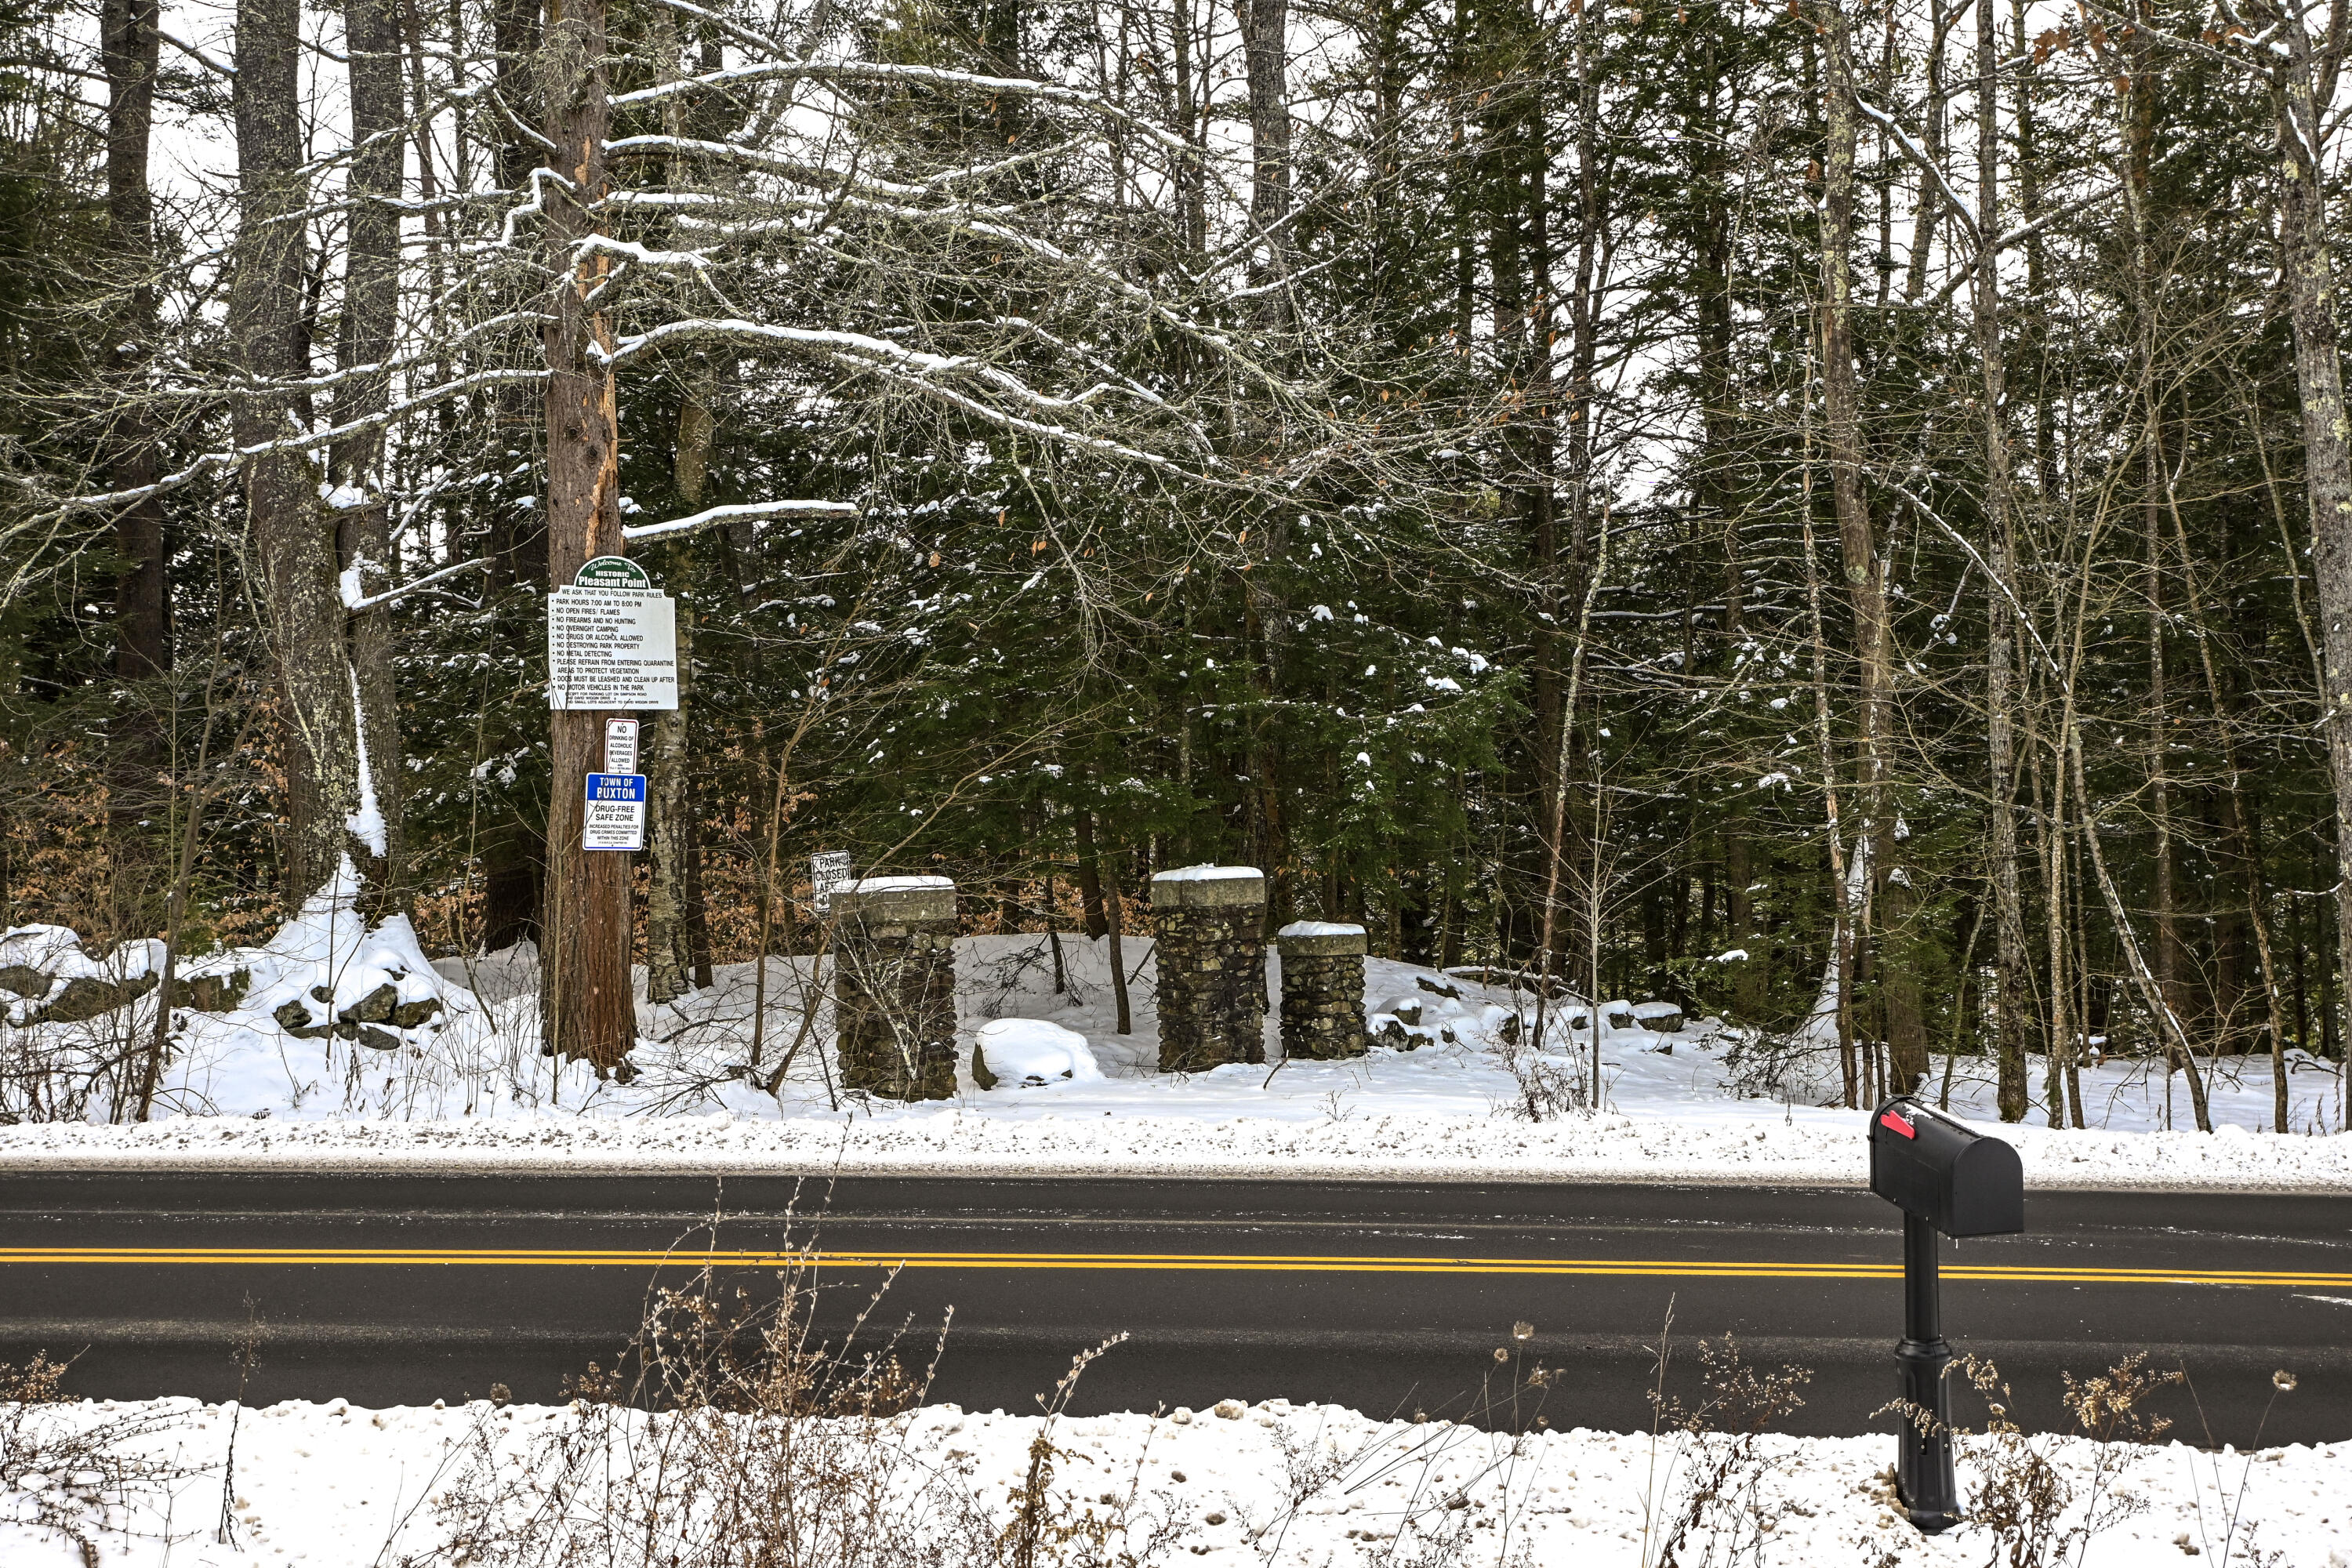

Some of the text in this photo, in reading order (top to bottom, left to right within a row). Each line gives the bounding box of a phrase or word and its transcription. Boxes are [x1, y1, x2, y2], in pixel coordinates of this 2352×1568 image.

[589, 559, 637, 572] Welcome To
[579, 576, 646, 588] Pleasant Point
[600, 777, 633, 787] TOWN OF
[597, 787, 635, 799] BUXTON
[819, 856, 840, 868] PARK
[815, 868, 847, 881] CLOSED
